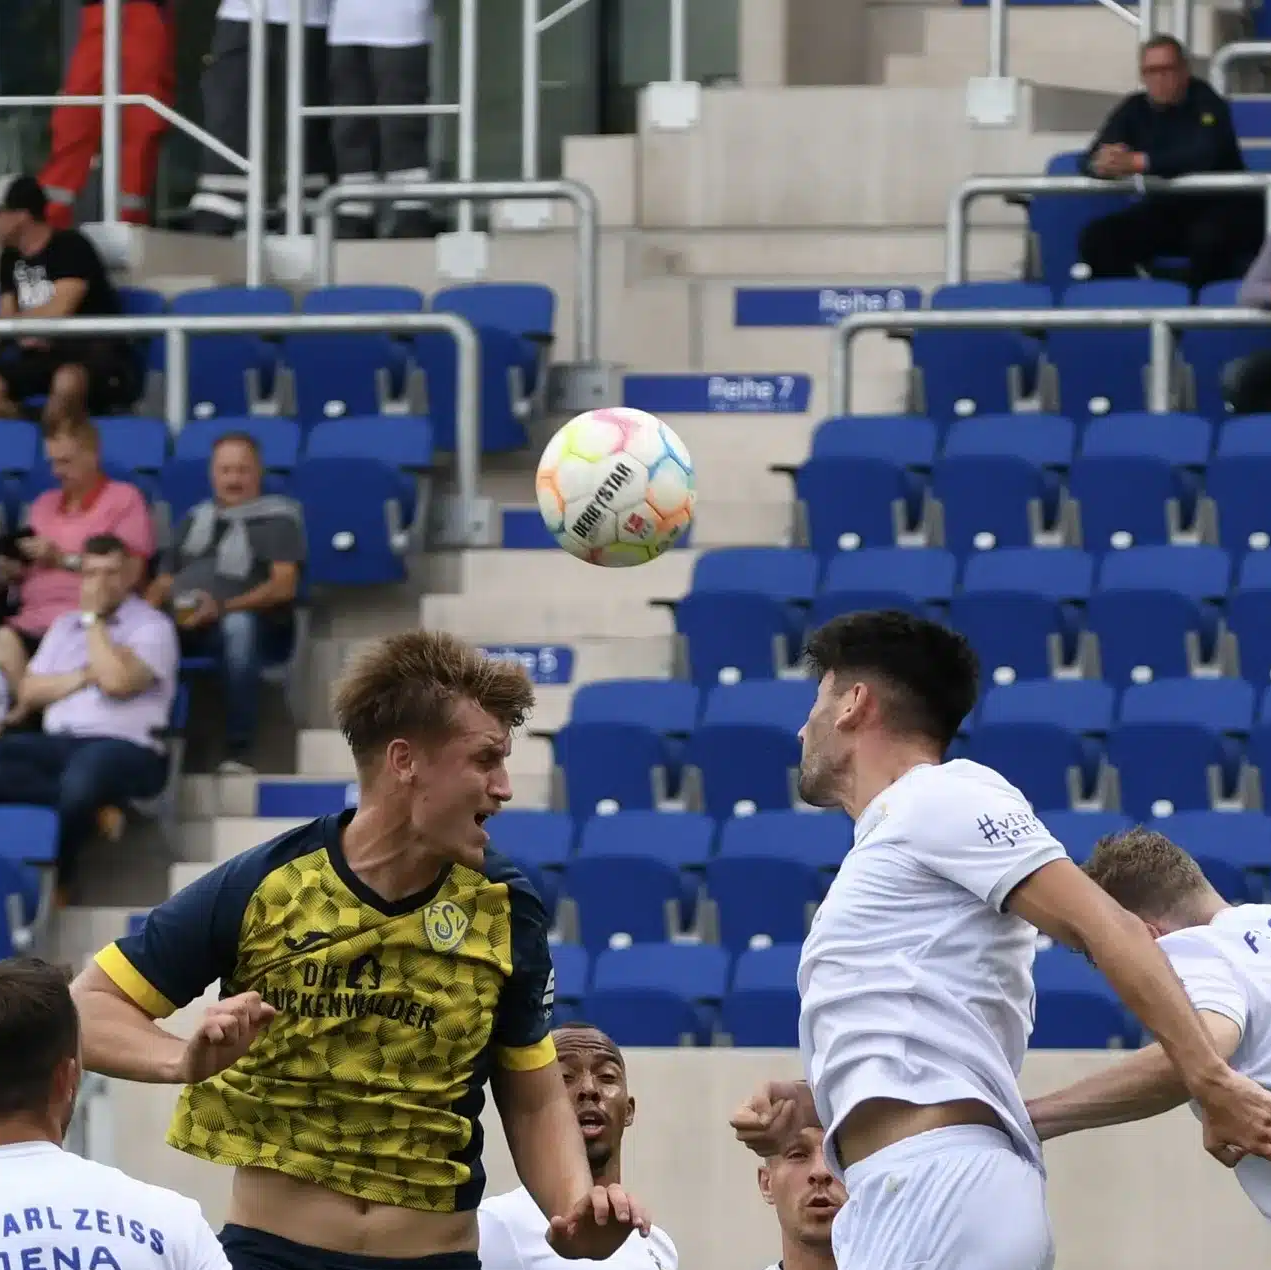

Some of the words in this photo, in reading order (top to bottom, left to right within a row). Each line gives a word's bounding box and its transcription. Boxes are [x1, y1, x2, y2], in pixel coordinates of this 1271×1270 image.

[707, 376, 775, 400] Reihe
[777, 376, 795, 399] 7
[572, 462, 632, 539] DERBYSTAR
[538, 647, 558, 674] 5
[74, 1207, 166, 1256] ZEISS
